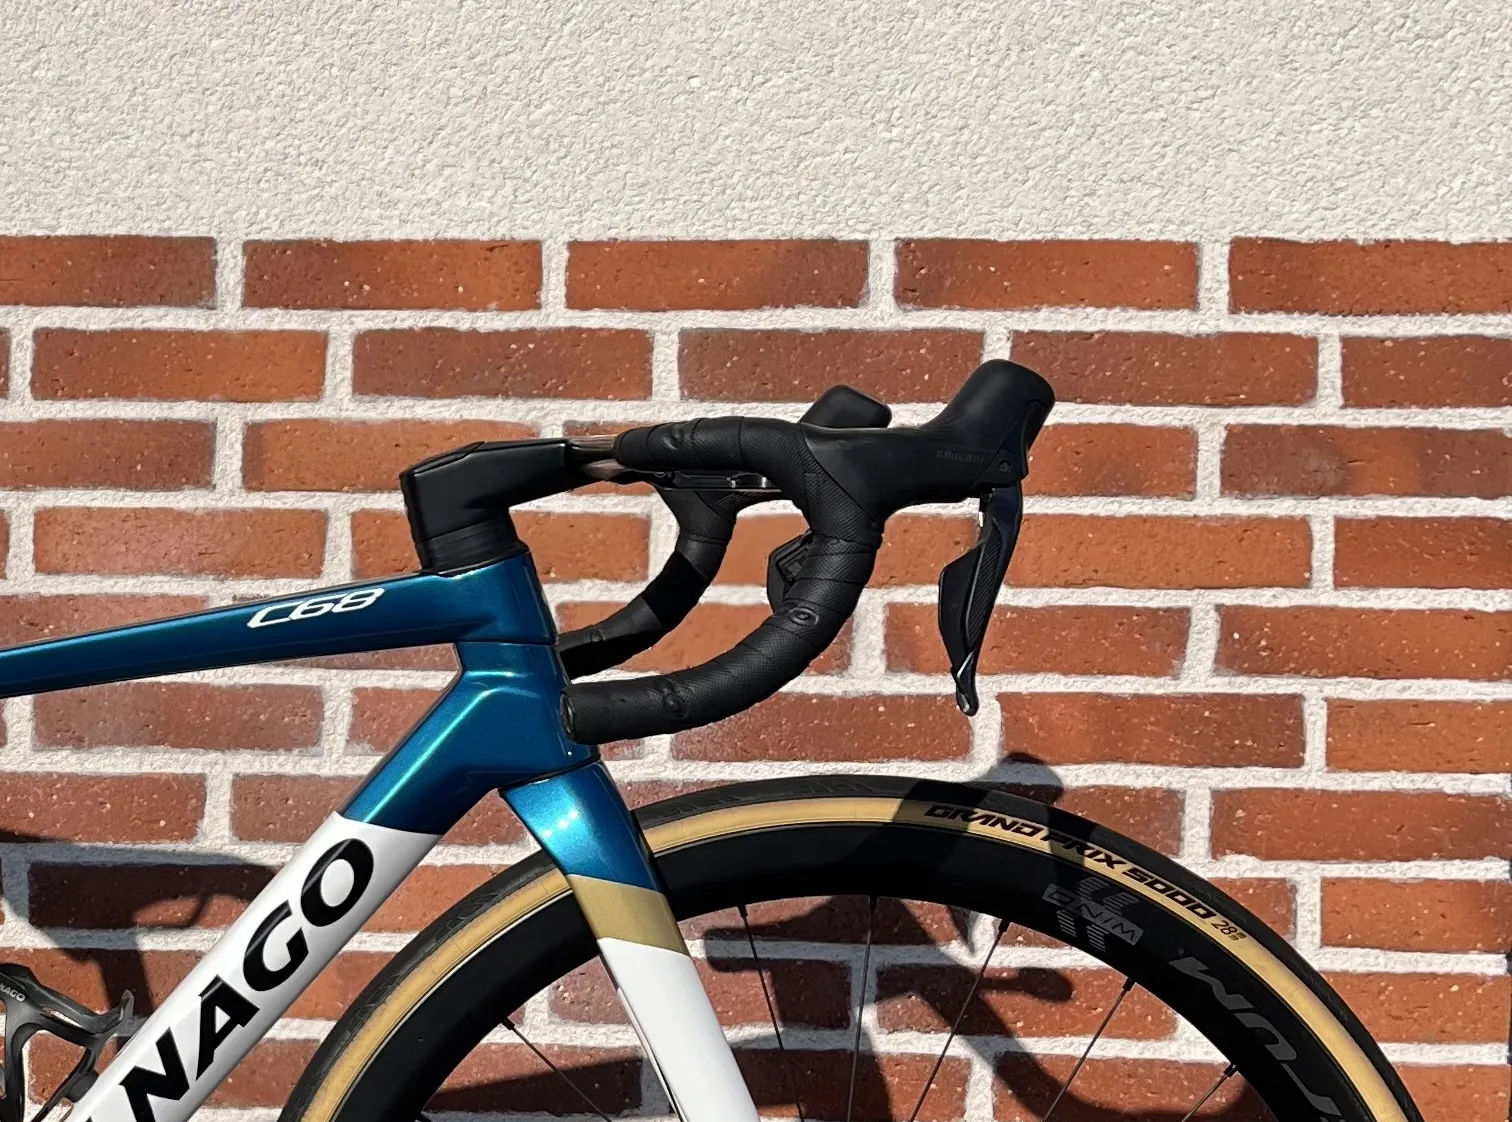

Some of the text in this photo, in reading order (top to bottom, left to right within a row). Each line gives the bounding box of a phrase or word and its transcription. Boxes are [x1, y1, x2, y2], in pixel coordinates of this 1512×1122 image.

[246, 587, 385, 629] C68
[924, 804, 1044, 838] GRAND
[1040, 833, 1128, 870] PRIX
[1121, 867, 1217, 920] 5000
[1046, 888, 1138, 942] WIND
